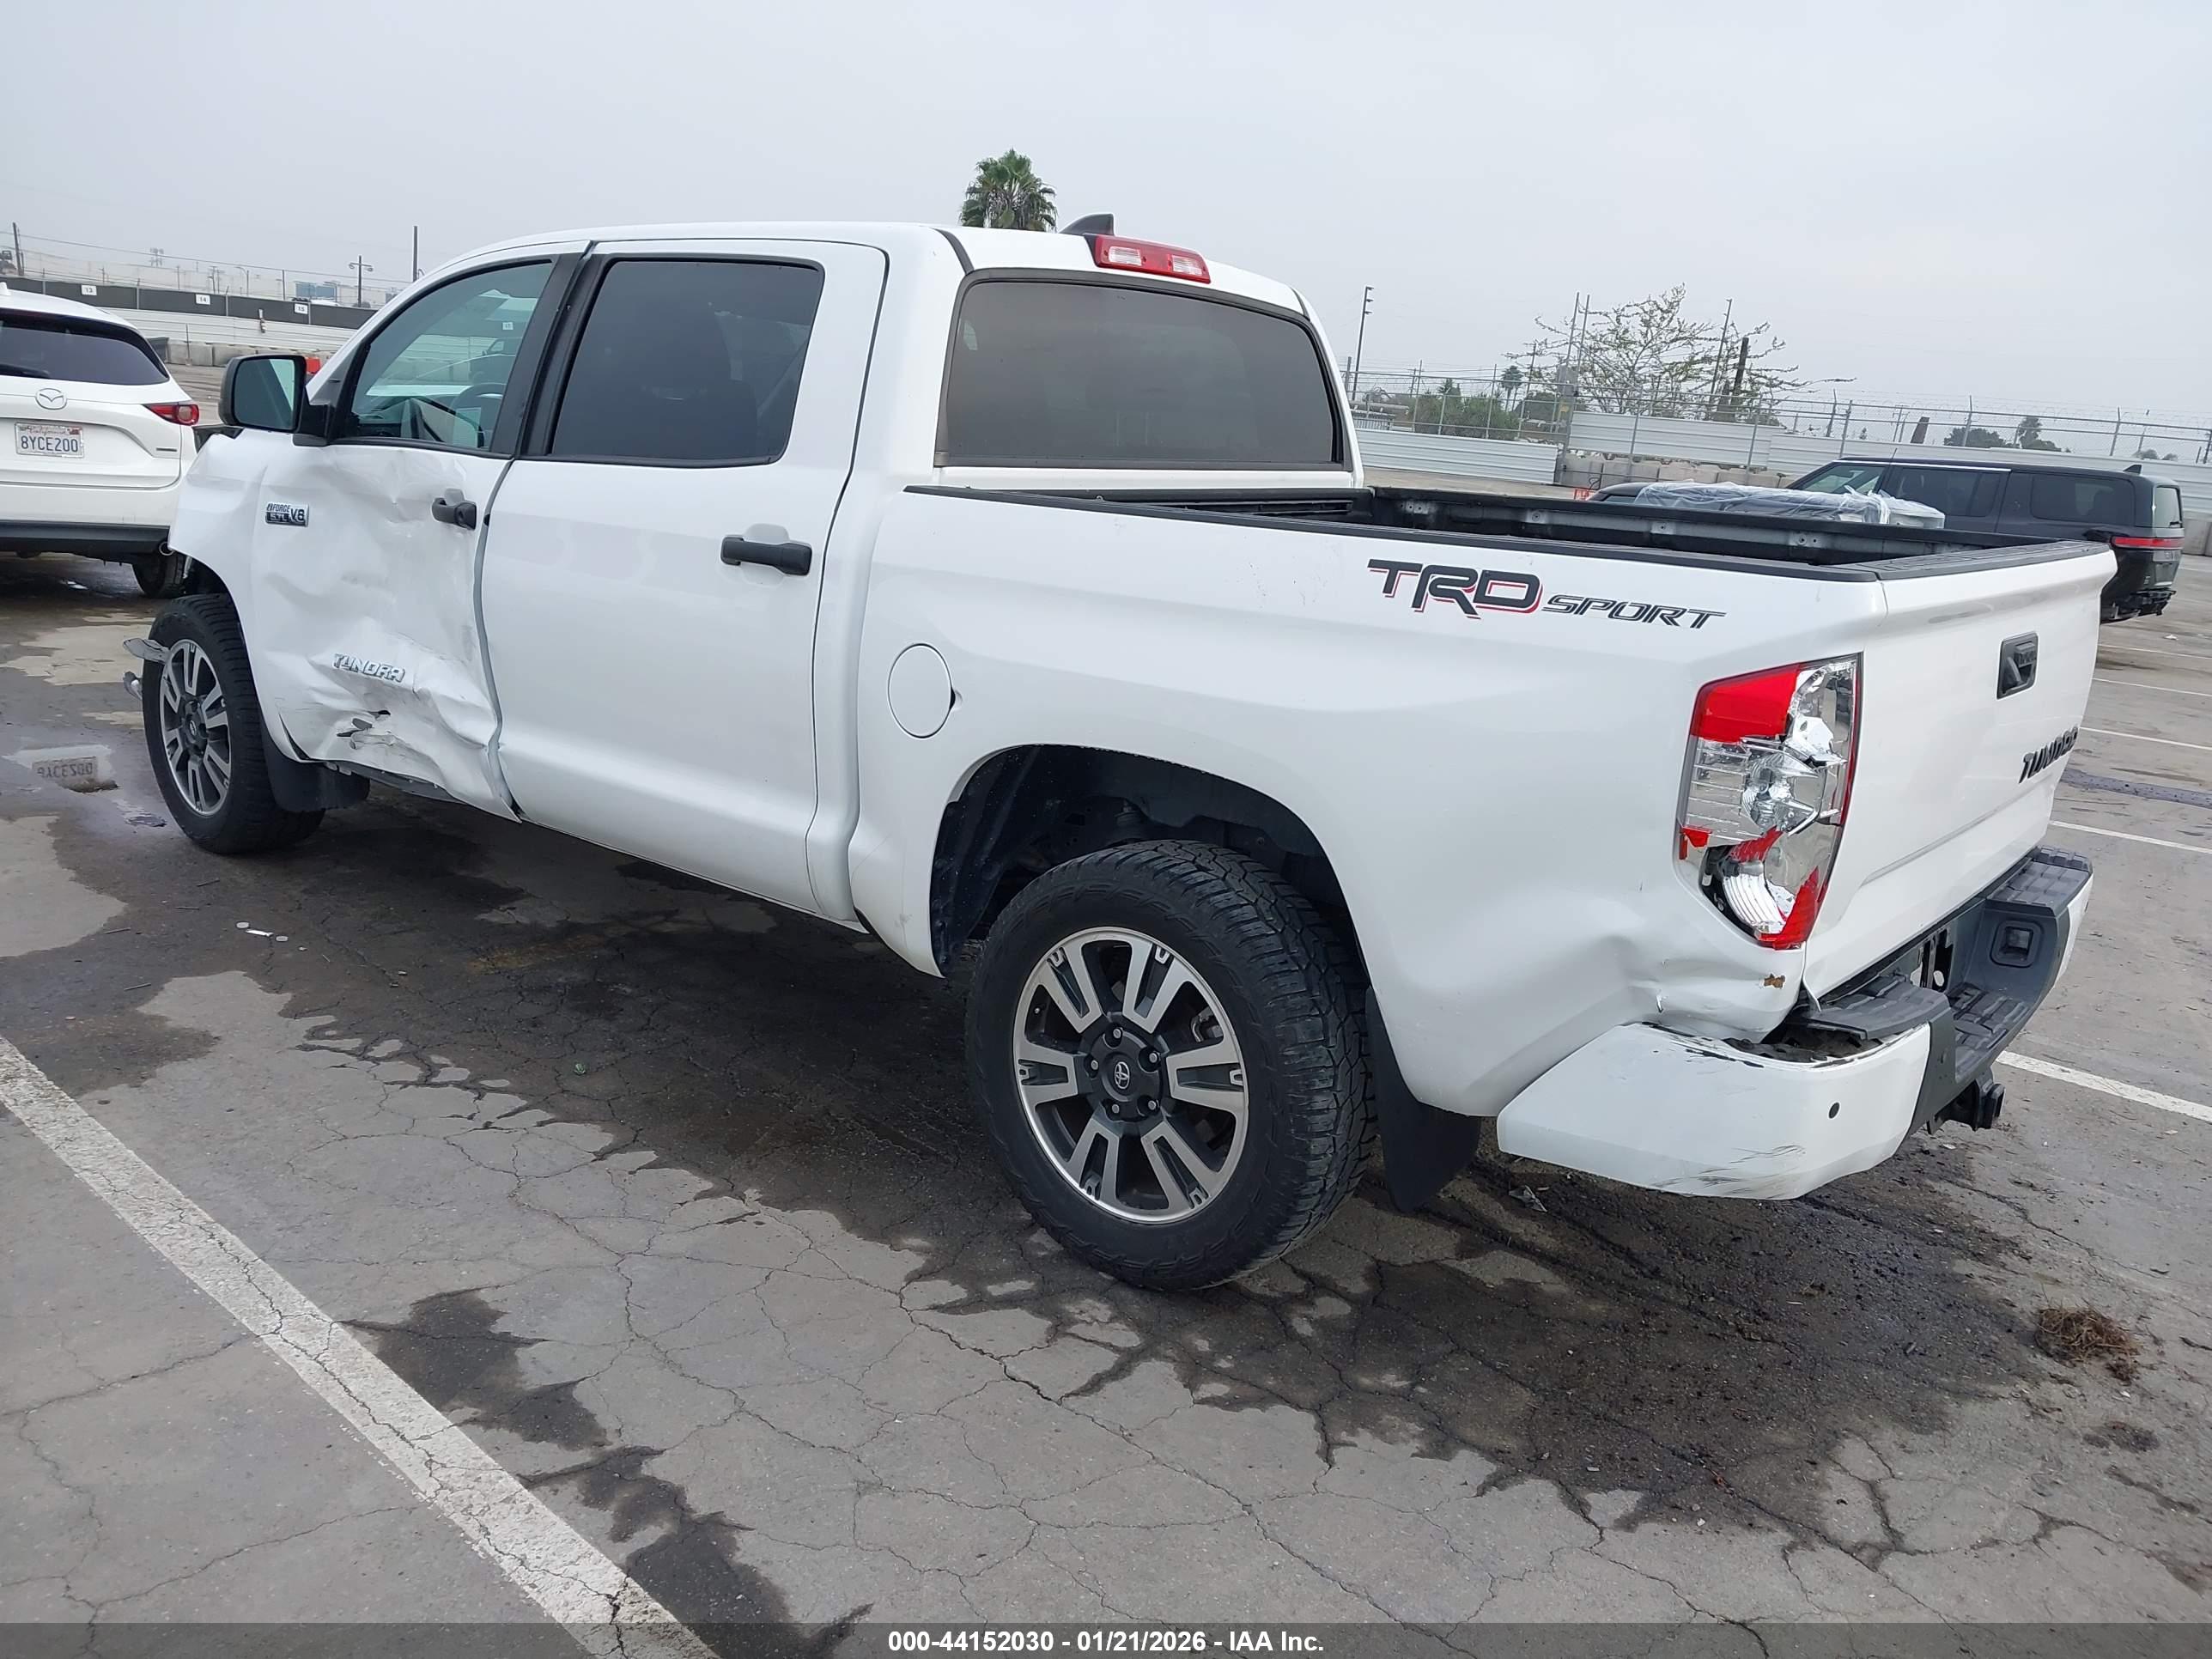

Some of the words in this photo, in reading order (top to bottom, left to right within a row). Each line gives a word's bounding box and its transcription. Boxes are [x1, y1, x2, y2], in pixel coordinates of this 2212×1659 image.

[21, 435, 79, 453] 8YCE200
[290, 507, 306, 522] V8
[1367, 558, 1543, 620] TRD
[1541, 593, 1727, 629] SPORT
[332, 653, 405, 684] TUNDRA
